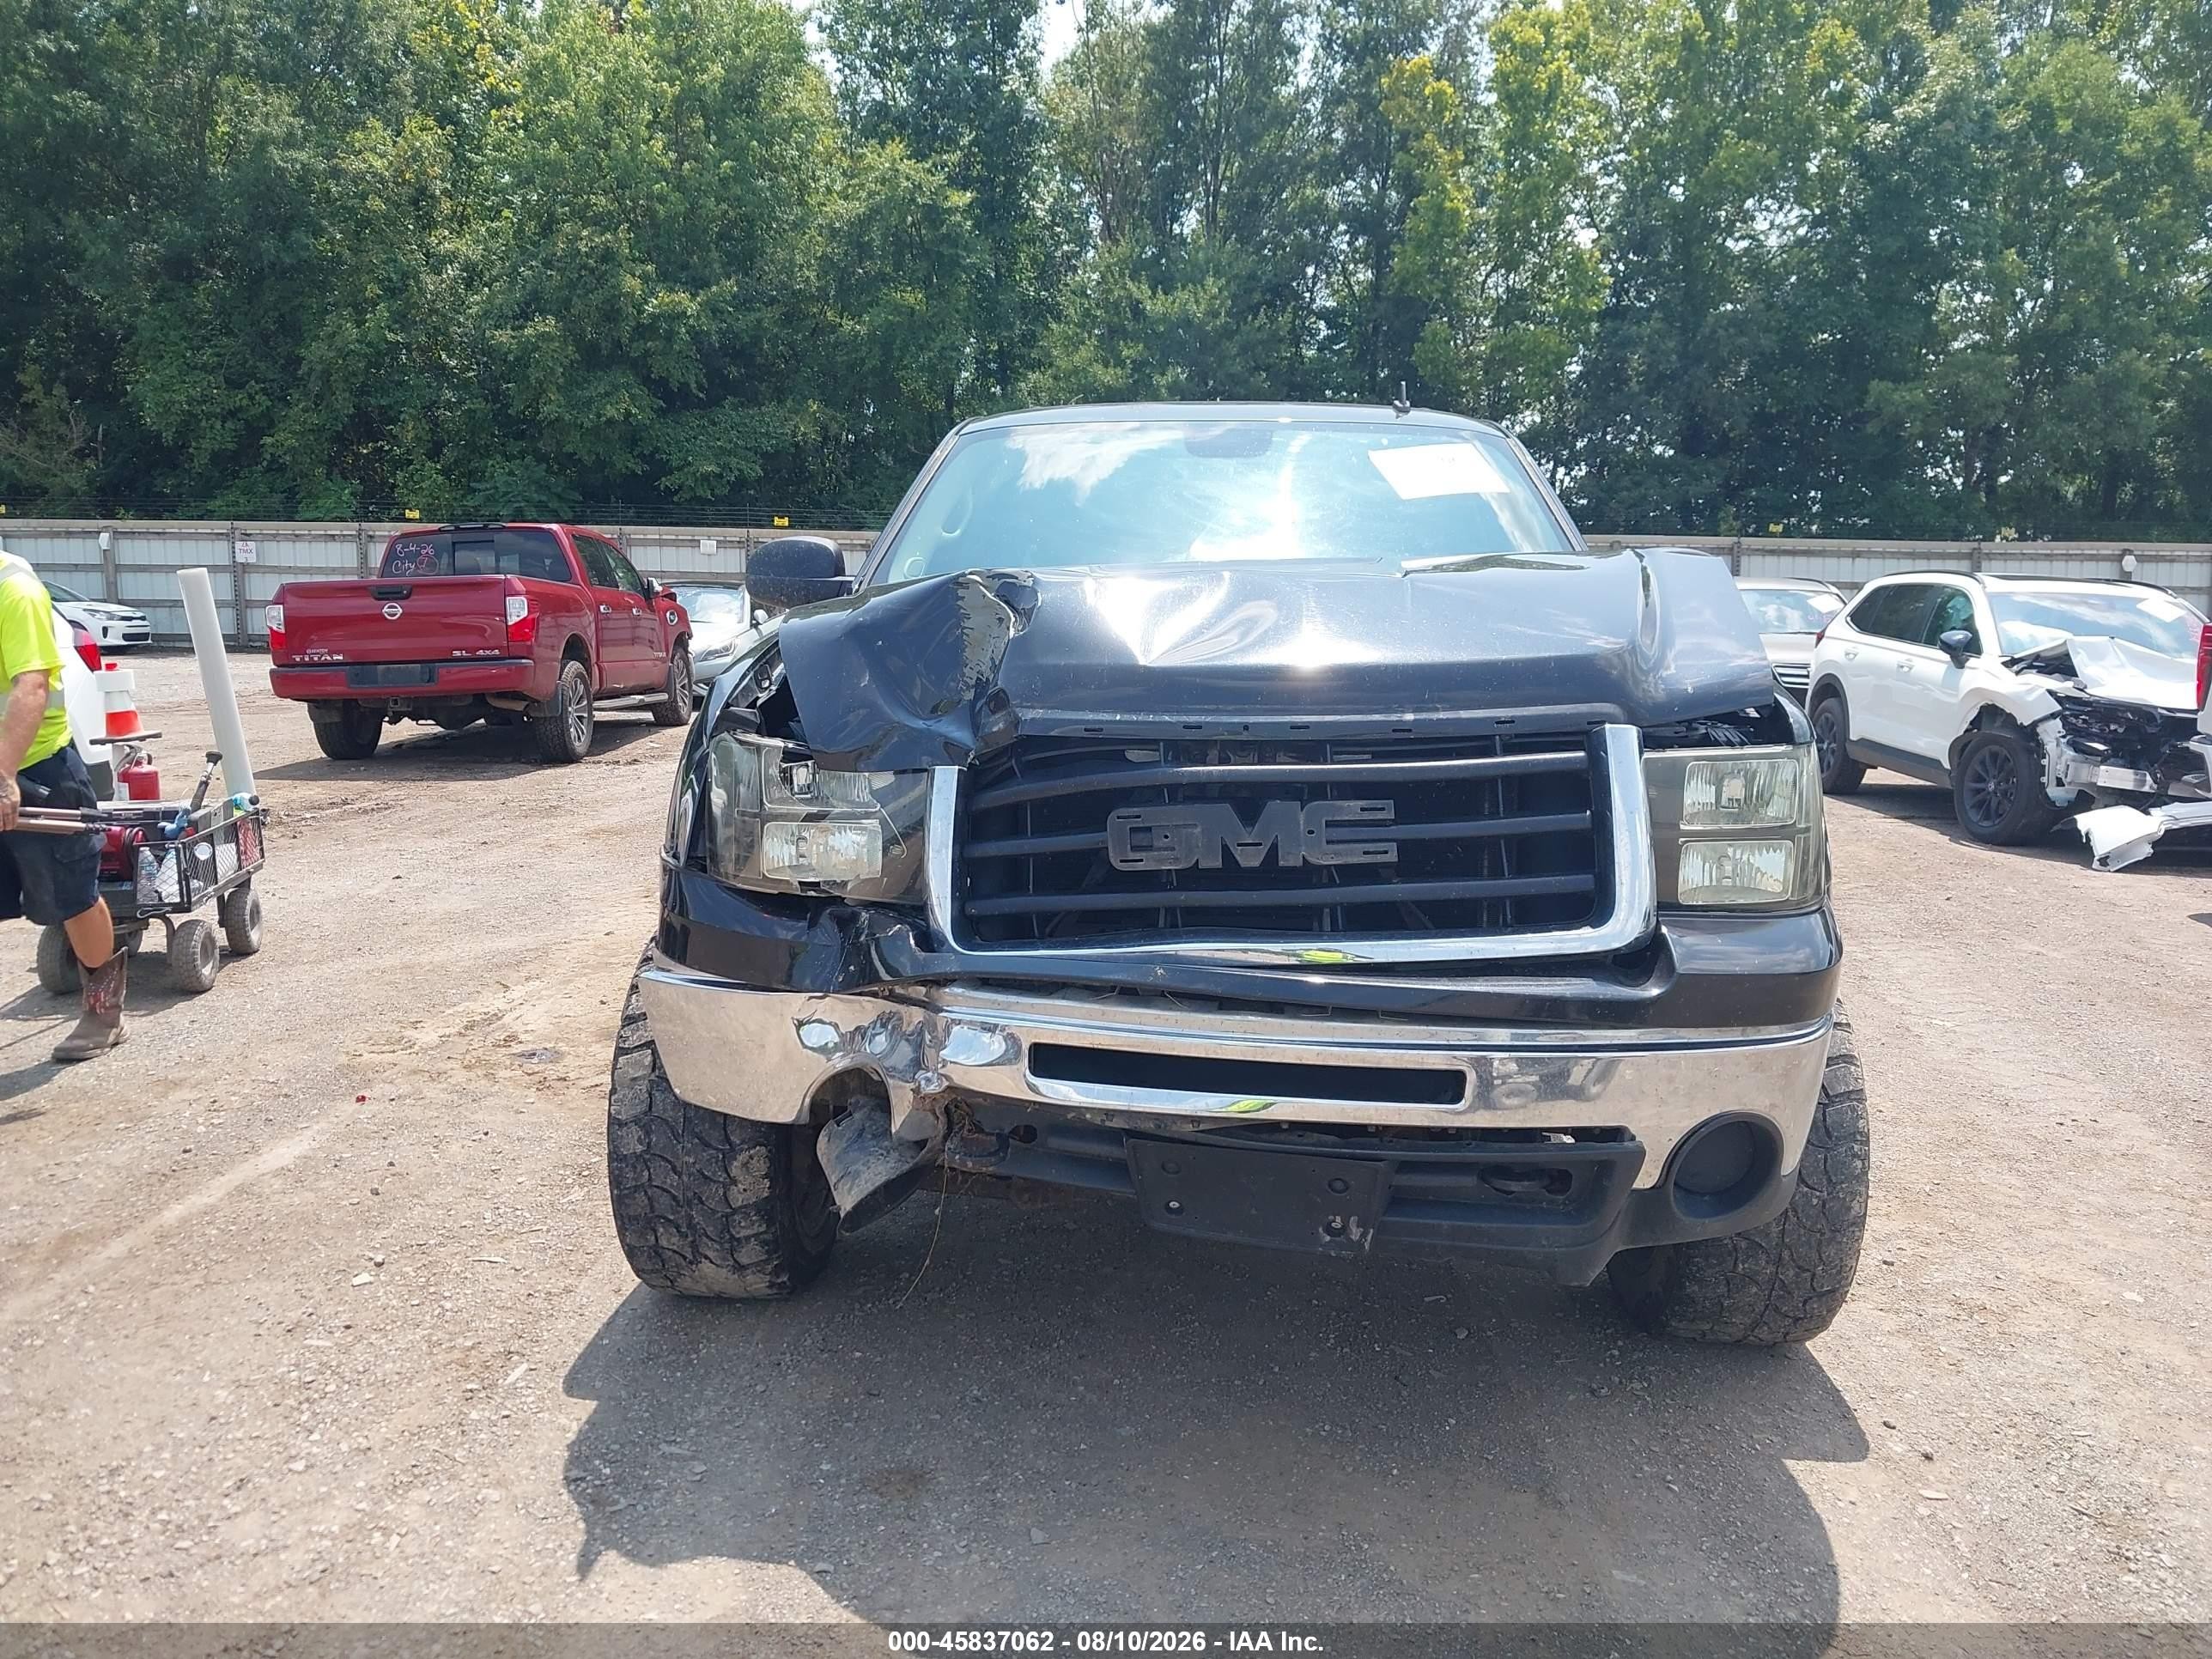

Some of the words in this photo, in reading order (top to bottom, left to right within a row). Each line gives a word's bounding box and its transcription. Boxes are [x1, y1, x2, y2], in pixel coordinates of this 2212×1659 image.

[395, 542, 434, 556] 8-4-26
[392, 559, 416, 576] City
[1106, 799, 1399, 872] GMC
